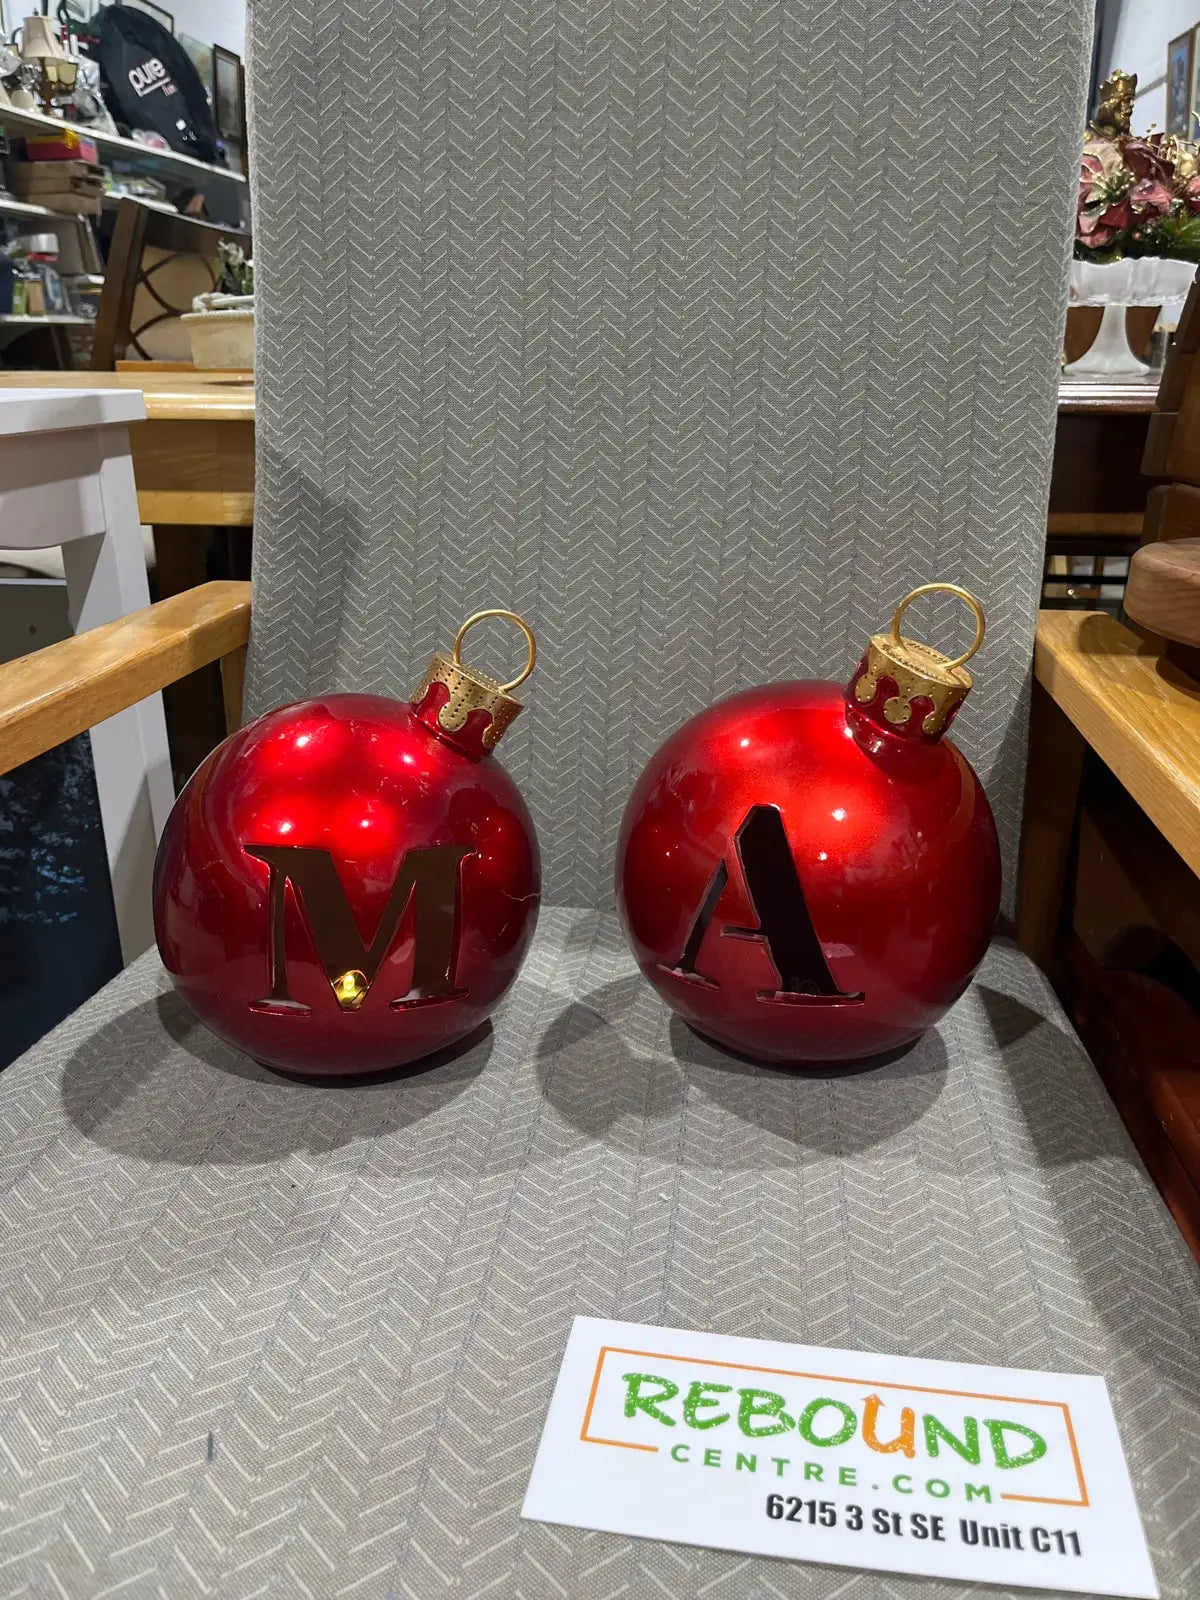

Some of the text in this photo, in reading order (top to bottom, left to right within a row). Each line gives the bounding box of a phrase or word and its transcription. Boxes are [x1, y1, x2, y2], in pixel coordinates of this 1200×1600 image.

[128, 58, 166, 97] pure
[243, 843, 476, 1014] M
[656, 803, 865, 1007] A
[622, 1372, 1048, 1469] REBOUND
[671, 1444, 993, 1503] CENTRE.COM
[766, 1494, 1082, 1557] 6215 3 St SE Unit C11
